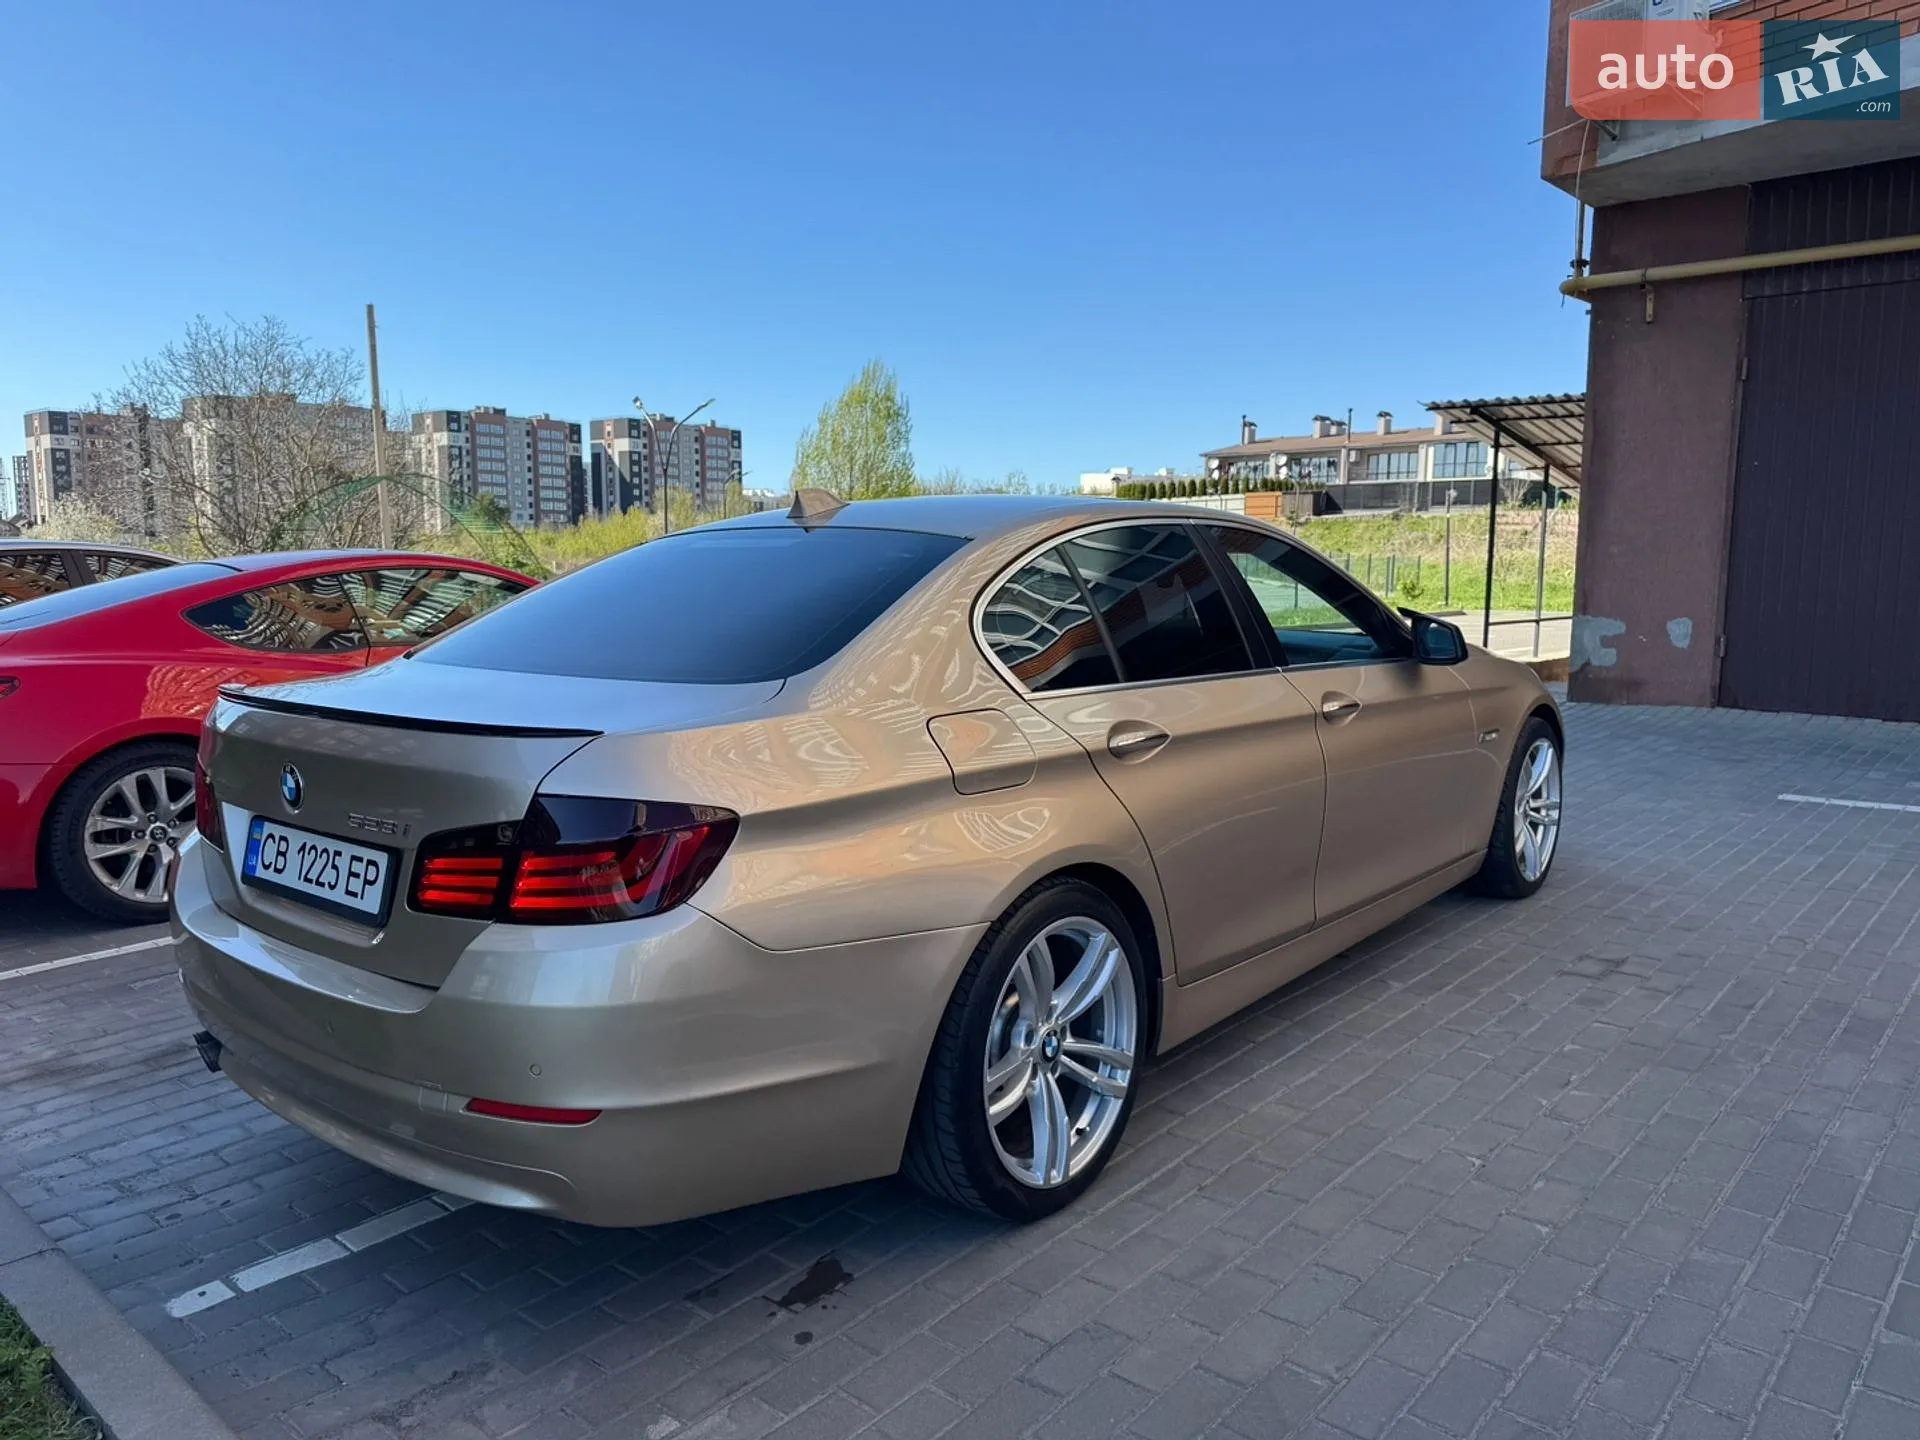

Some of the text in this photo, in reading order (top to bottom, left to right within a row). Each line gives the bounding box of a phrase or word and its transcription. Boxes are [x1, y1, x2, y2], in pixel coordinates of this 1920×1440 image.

[260, 833, 380, 900] CB 1225 EP
